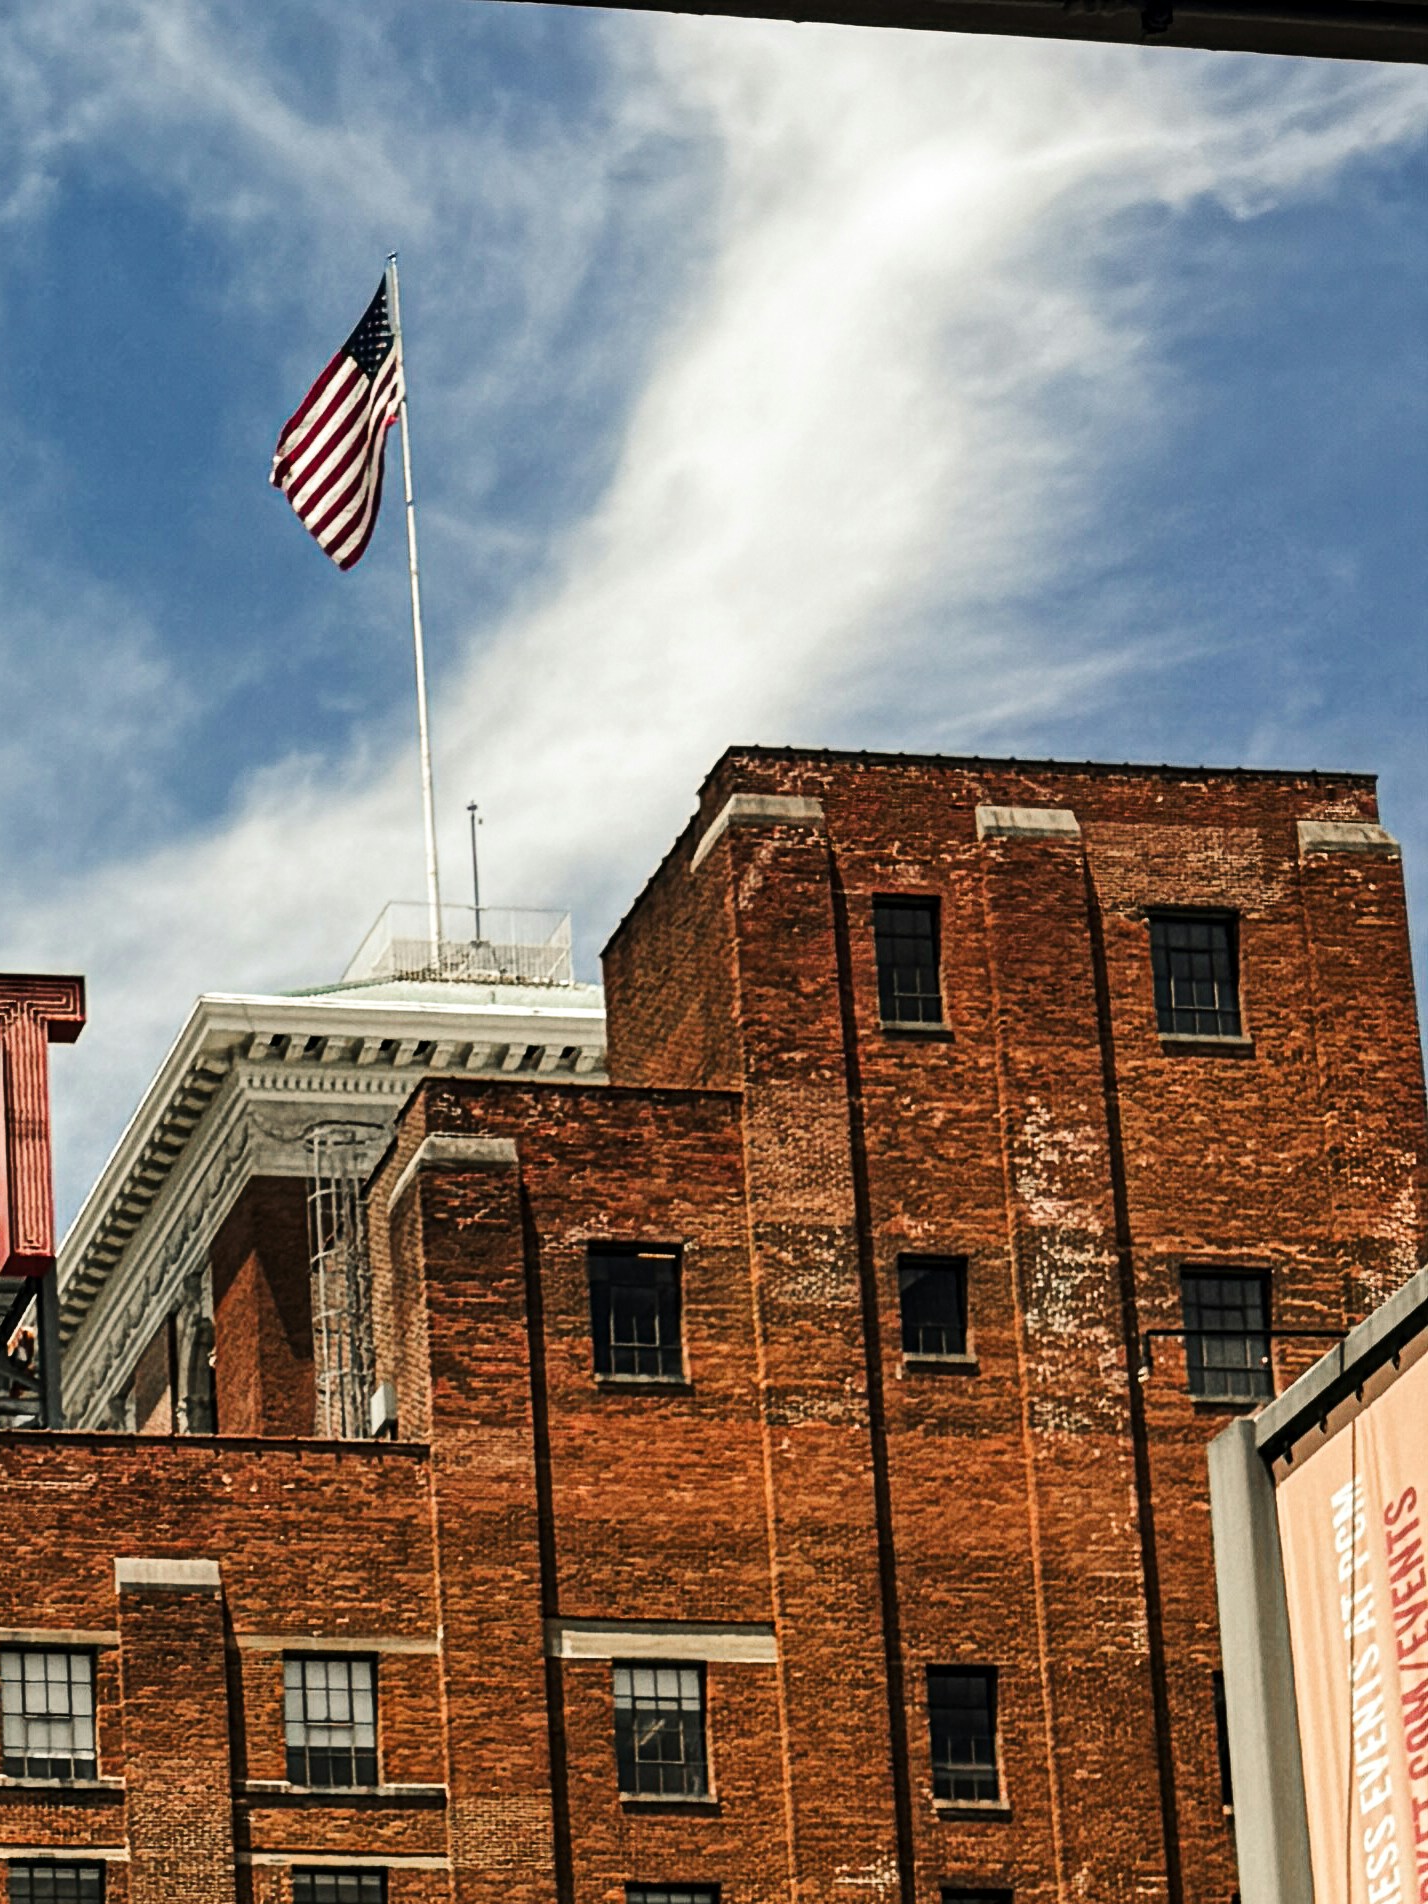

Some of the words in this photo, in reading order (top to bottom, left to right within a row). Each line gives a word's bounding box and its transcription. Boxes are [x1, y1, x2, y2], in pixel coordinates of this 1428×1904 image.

[1330, 1475, 1371, 1582] PCM
[1340, 1581, 1378, 1643] AT
[1350, 1640, 1394, 1813] EVENTS
